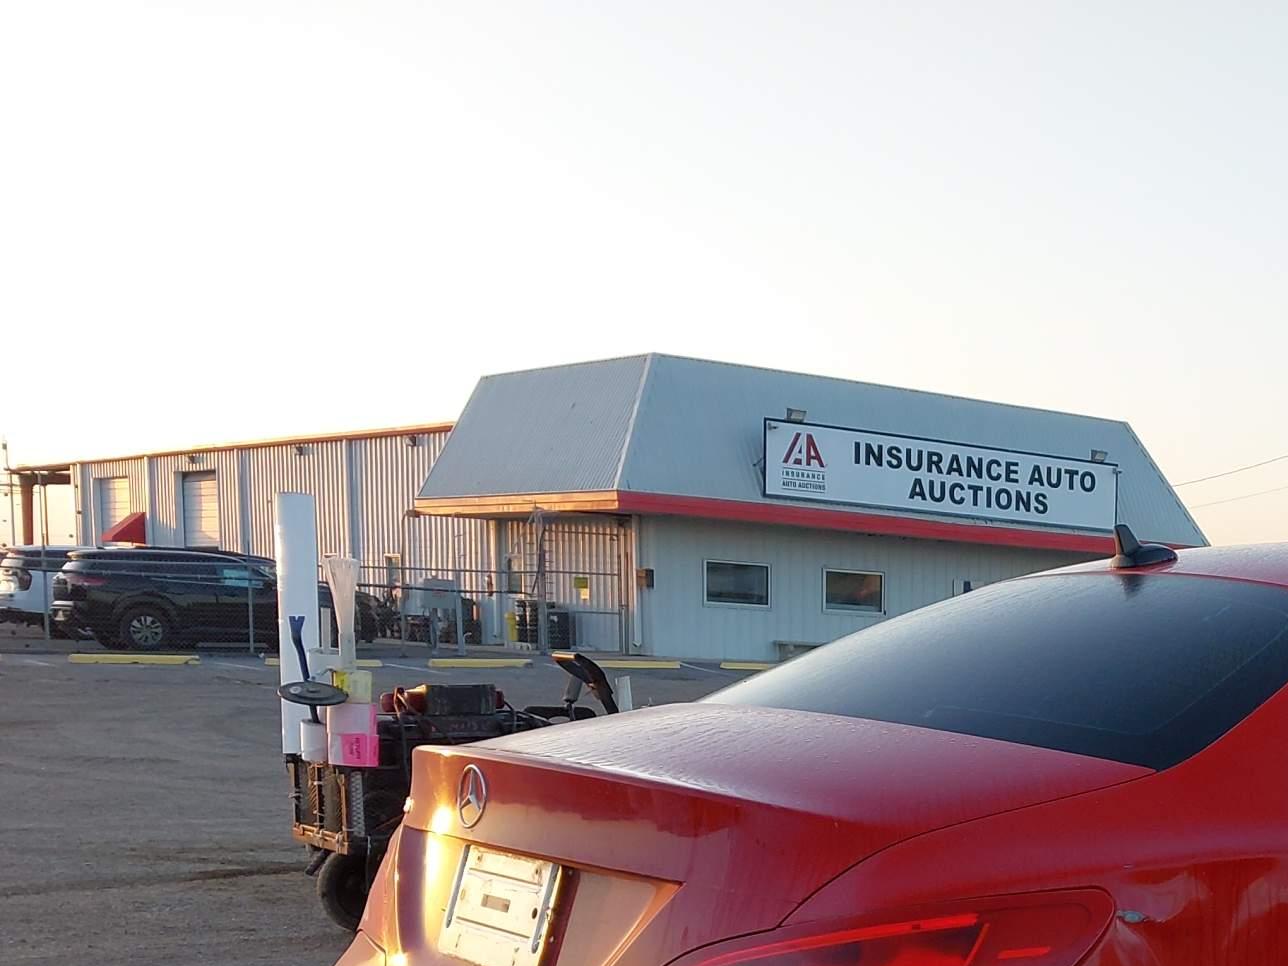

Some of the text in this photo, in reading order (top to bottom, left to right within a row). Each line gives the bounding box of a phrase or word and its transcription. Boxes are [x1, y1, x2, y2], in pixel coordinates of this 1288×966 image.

[782, 469, 826, 480] INSURANCE
[853, 441, 1097, 493] INSURANCE AUTO
[782, 480, 826, 491] AUTO AUCTIONS
[908, 477, 1050, 514] AUCTIONS
